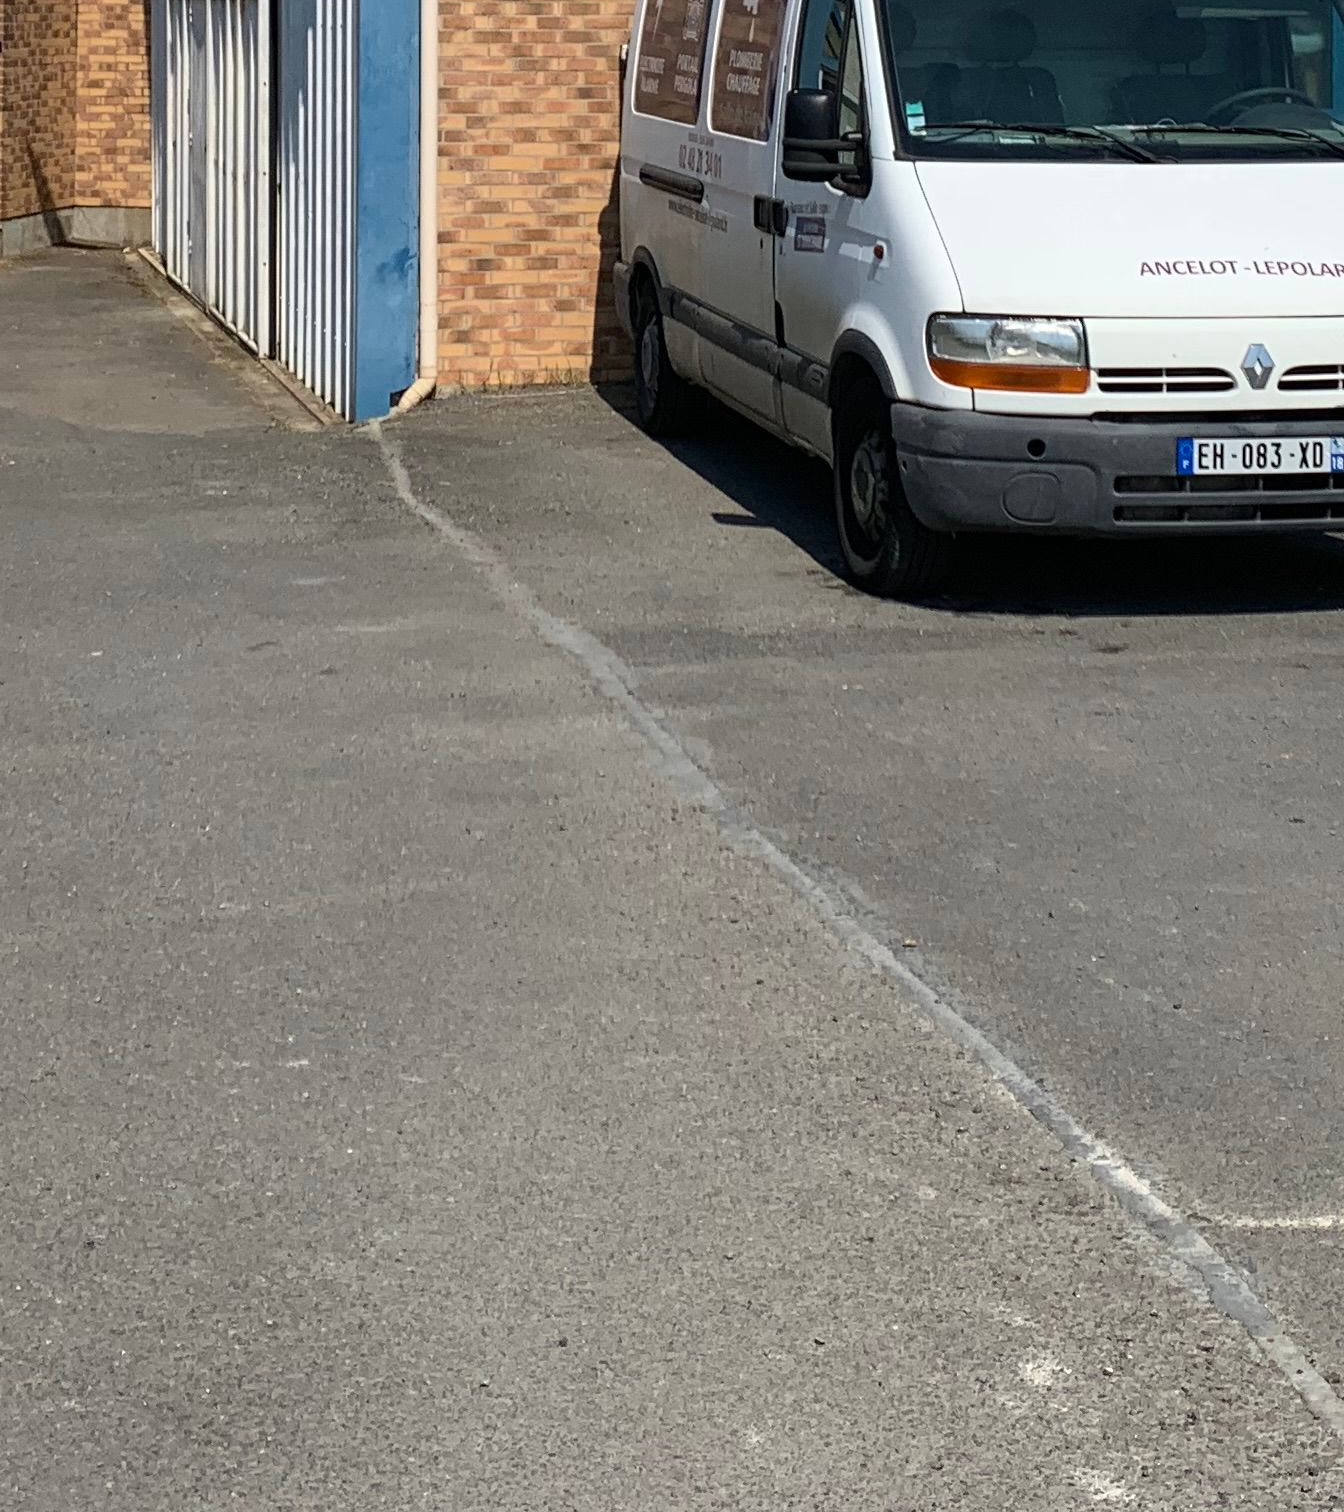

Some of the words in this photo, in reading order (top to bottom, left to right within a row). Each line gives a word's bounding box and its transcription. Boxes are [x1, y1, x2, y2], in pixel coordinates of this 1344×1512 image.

[726, 72, 761, 96] CHAUFFAGE
[1140, 260, 1238, 276] ANCELOT
[1332, 457, 1344, 470] 18
